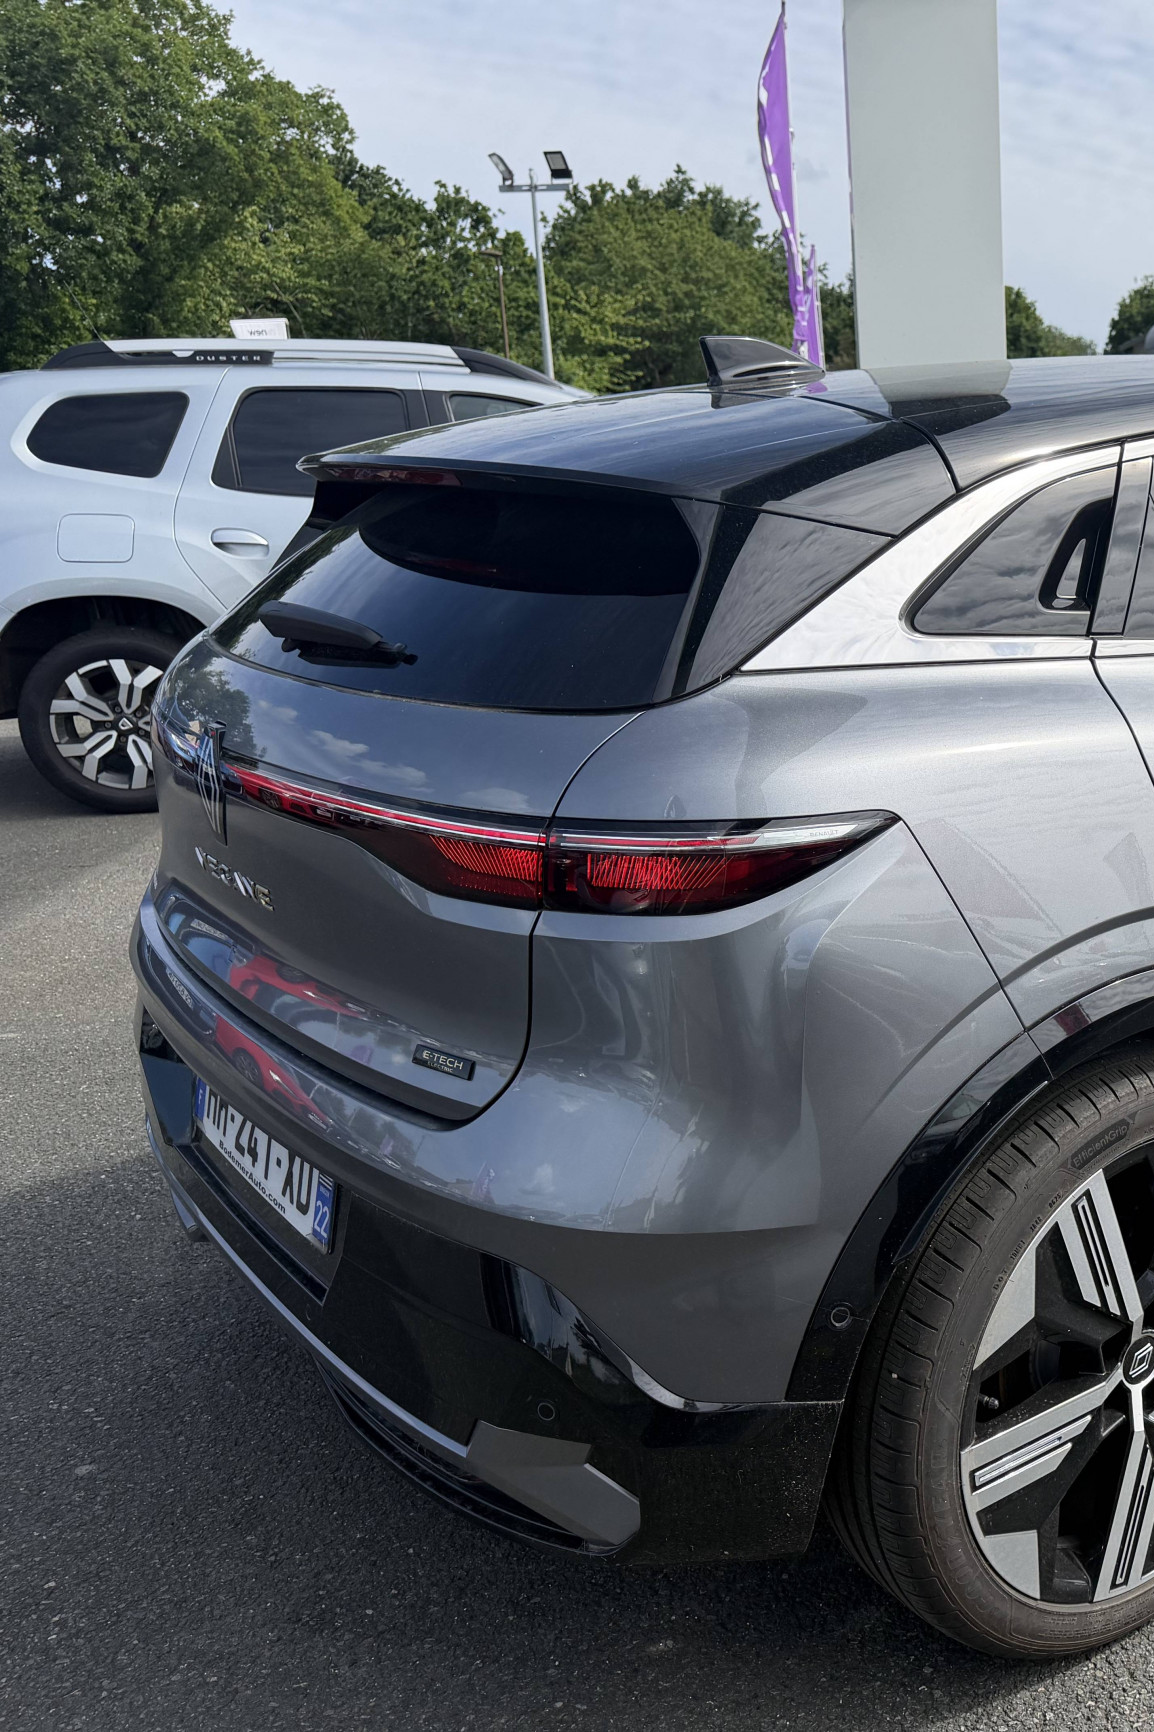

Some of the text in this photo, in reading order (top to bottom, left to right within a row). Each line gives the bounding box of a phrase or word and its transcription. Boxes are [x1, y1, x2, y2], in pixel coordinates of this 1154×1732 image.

[422, 1049, 464, 1070] E-TECH
[427, 1061, 454, 1073] ELECTRIC
[218, 1139, 287, 1215] BodemerAuto.com
[313, 1199, 331, 1240] 22
